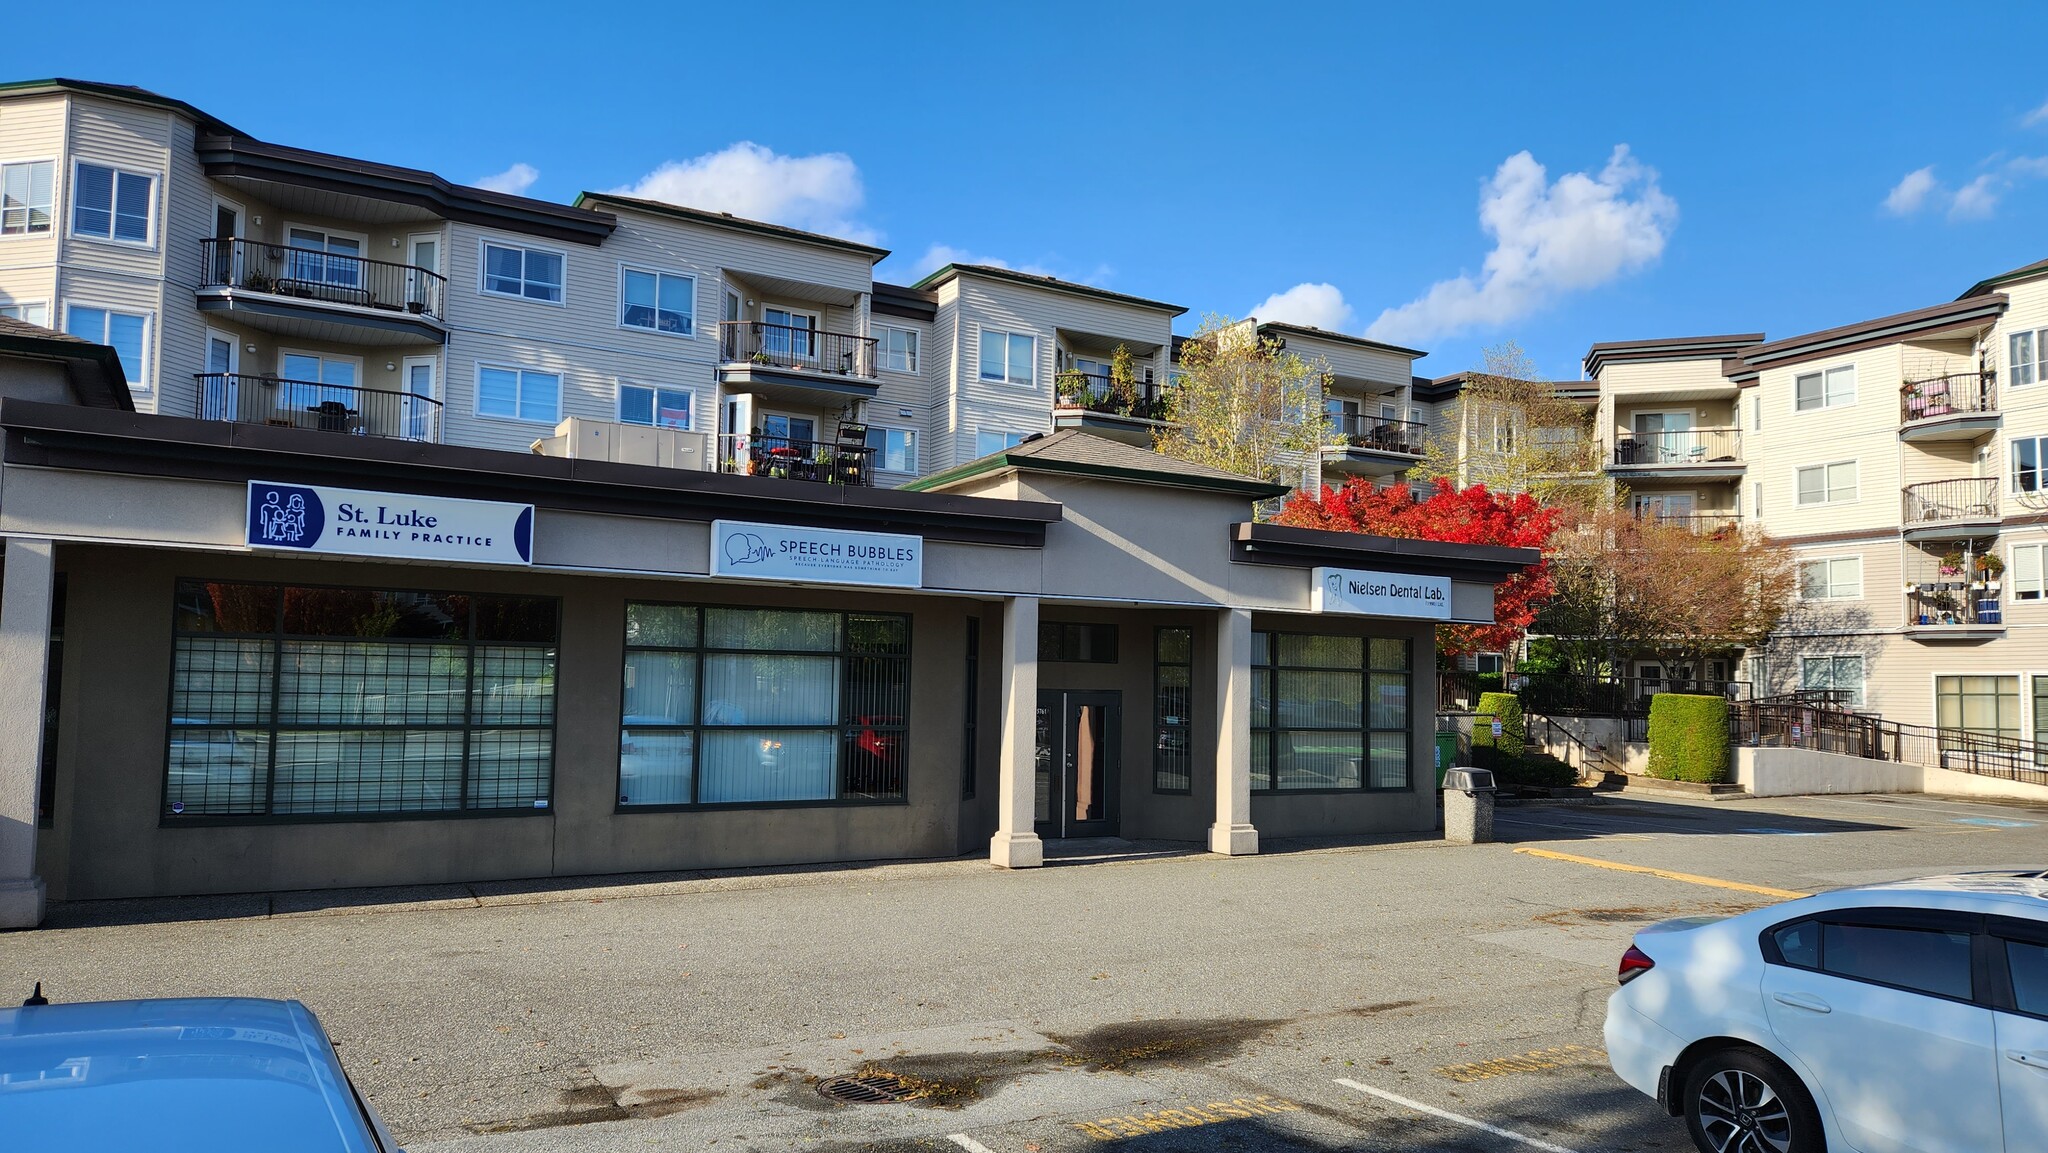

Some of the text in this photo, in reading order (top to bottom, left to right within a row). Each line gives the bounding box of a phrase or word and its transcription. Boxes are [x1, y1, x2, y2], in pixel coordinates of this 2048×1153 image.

[337, 503, 438, 528] St. Luke
[337, 527, 492, 547] FAMILY PRACTICE
[779, 540, 914, 561] SPEECH BUBBLES
[862, 559, 905, 568] PATHOLOGY
[1349, 581, 1445, 601] Nielsen Dental Lab.
[1073, 1094, 1301, 1141] CUSTOMER
